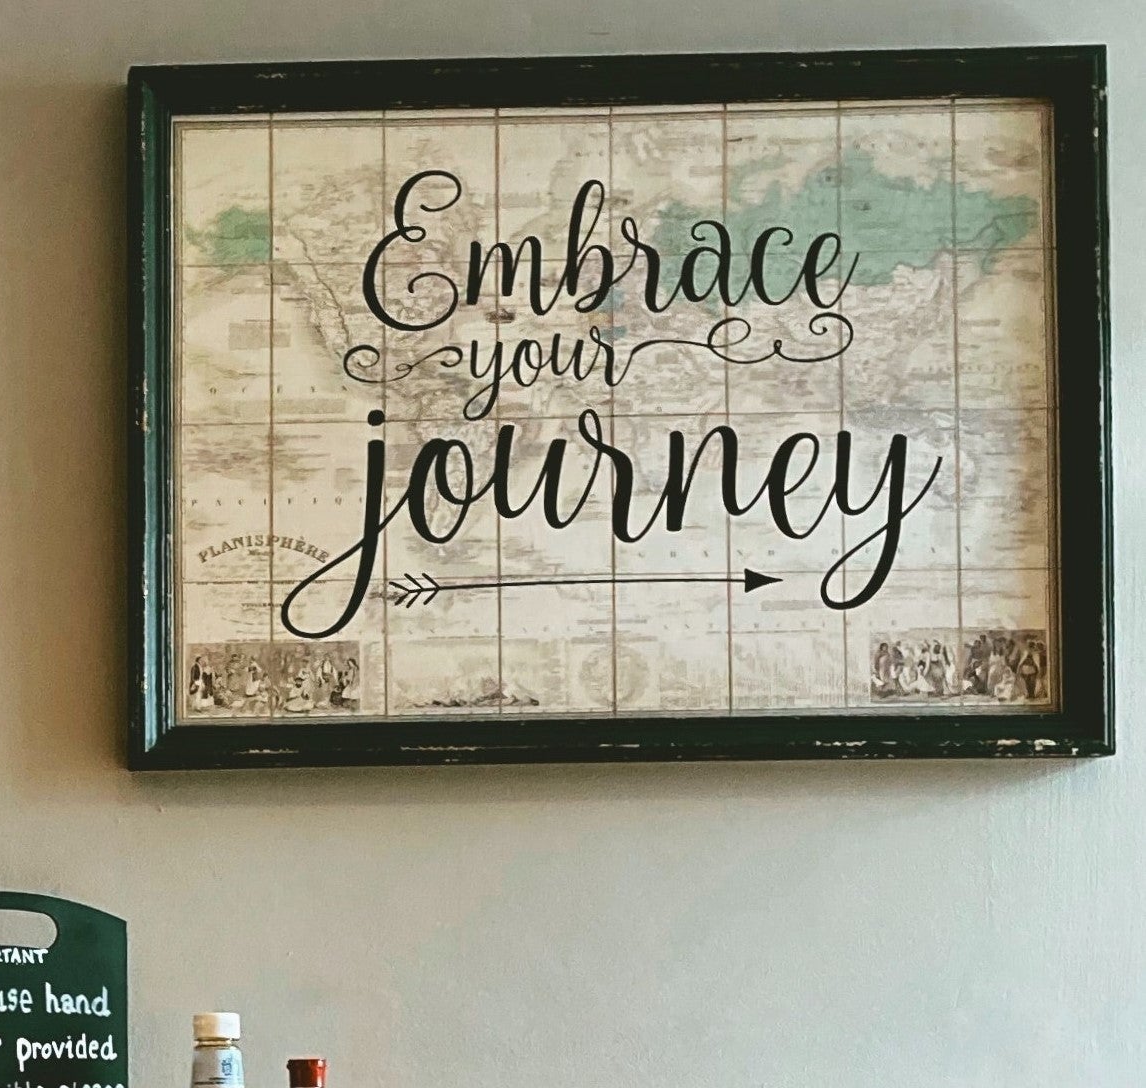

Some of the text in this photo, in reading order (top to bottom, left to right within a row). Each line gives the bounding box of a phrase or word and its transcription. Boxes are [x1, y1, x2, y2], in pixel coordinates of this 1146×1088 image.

[362, 170, 860, 332] Embrace
[461, 324, 632, 422] your
[280, 408, 943, 639] journey
[44, 981, 111, 1018] hand
[16, 1032, 118, 1073] provided
